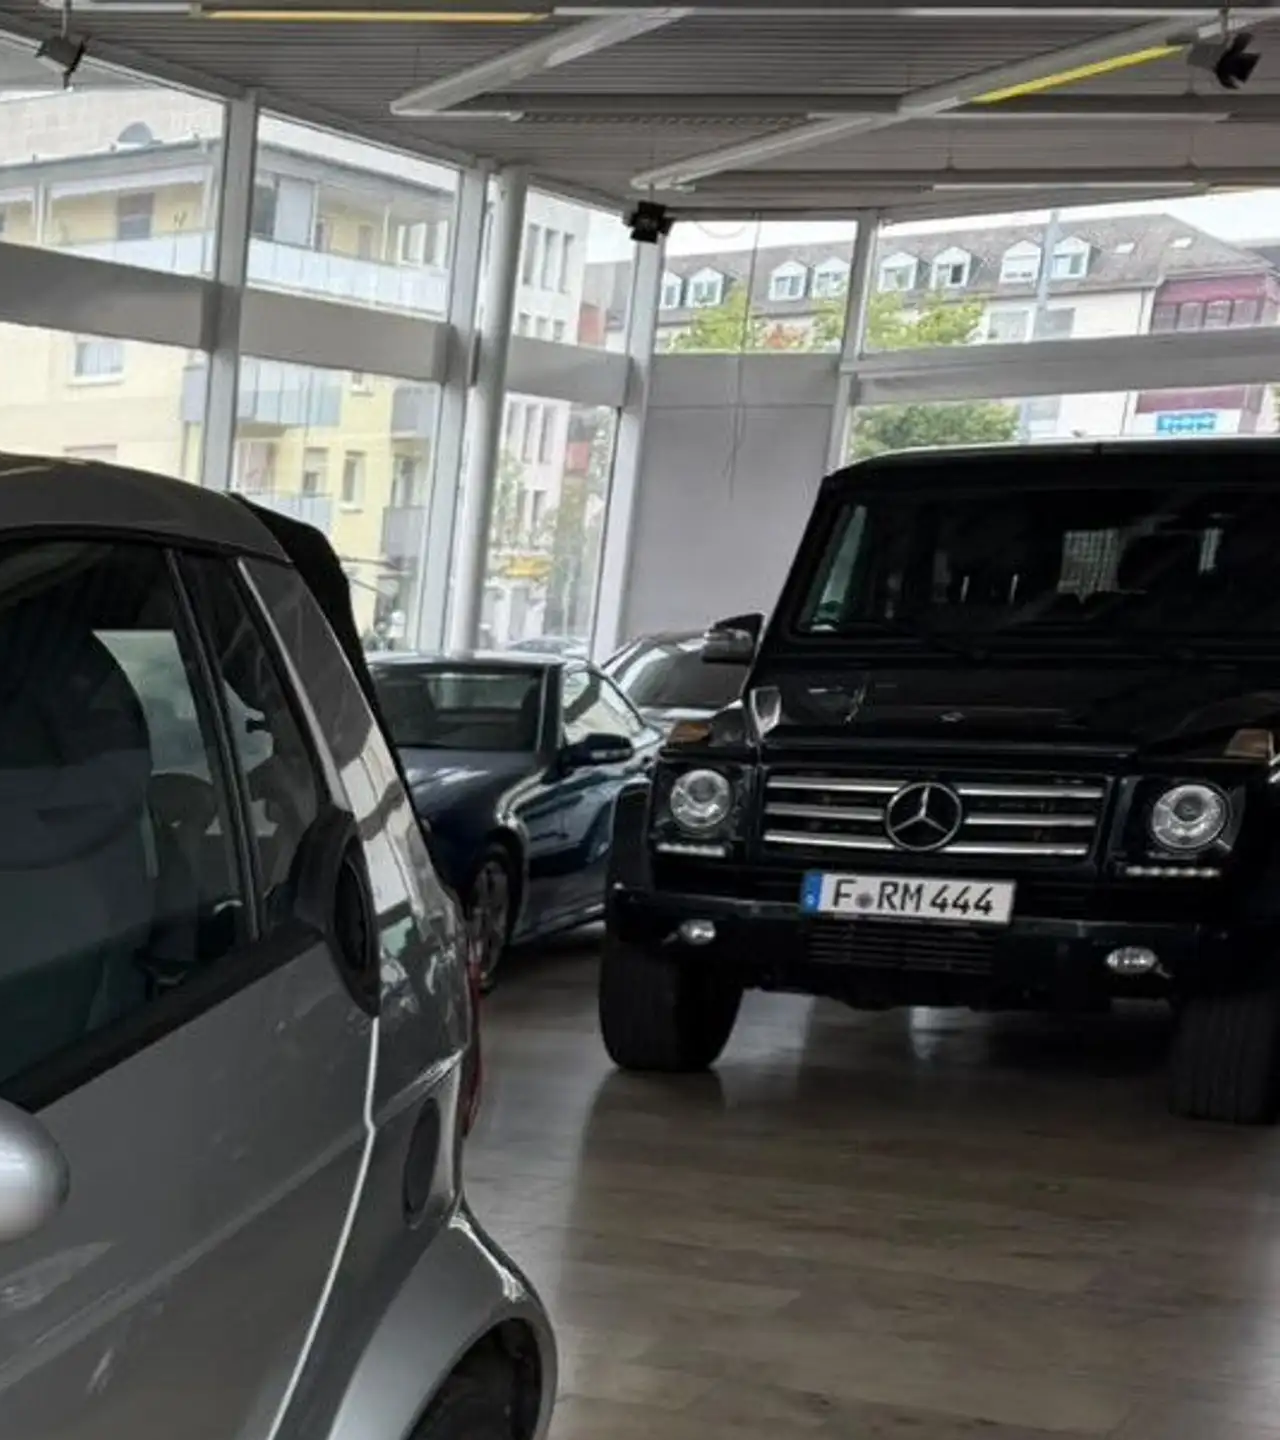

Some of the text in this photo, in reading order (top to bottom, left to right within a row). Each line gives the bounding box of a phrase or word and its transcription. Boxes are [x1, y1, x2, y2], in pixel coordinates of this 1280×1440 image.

[833, 878, 857, 908] F
[877, 880, 924, 912] RM
[930, 884, 994, 915] 444
